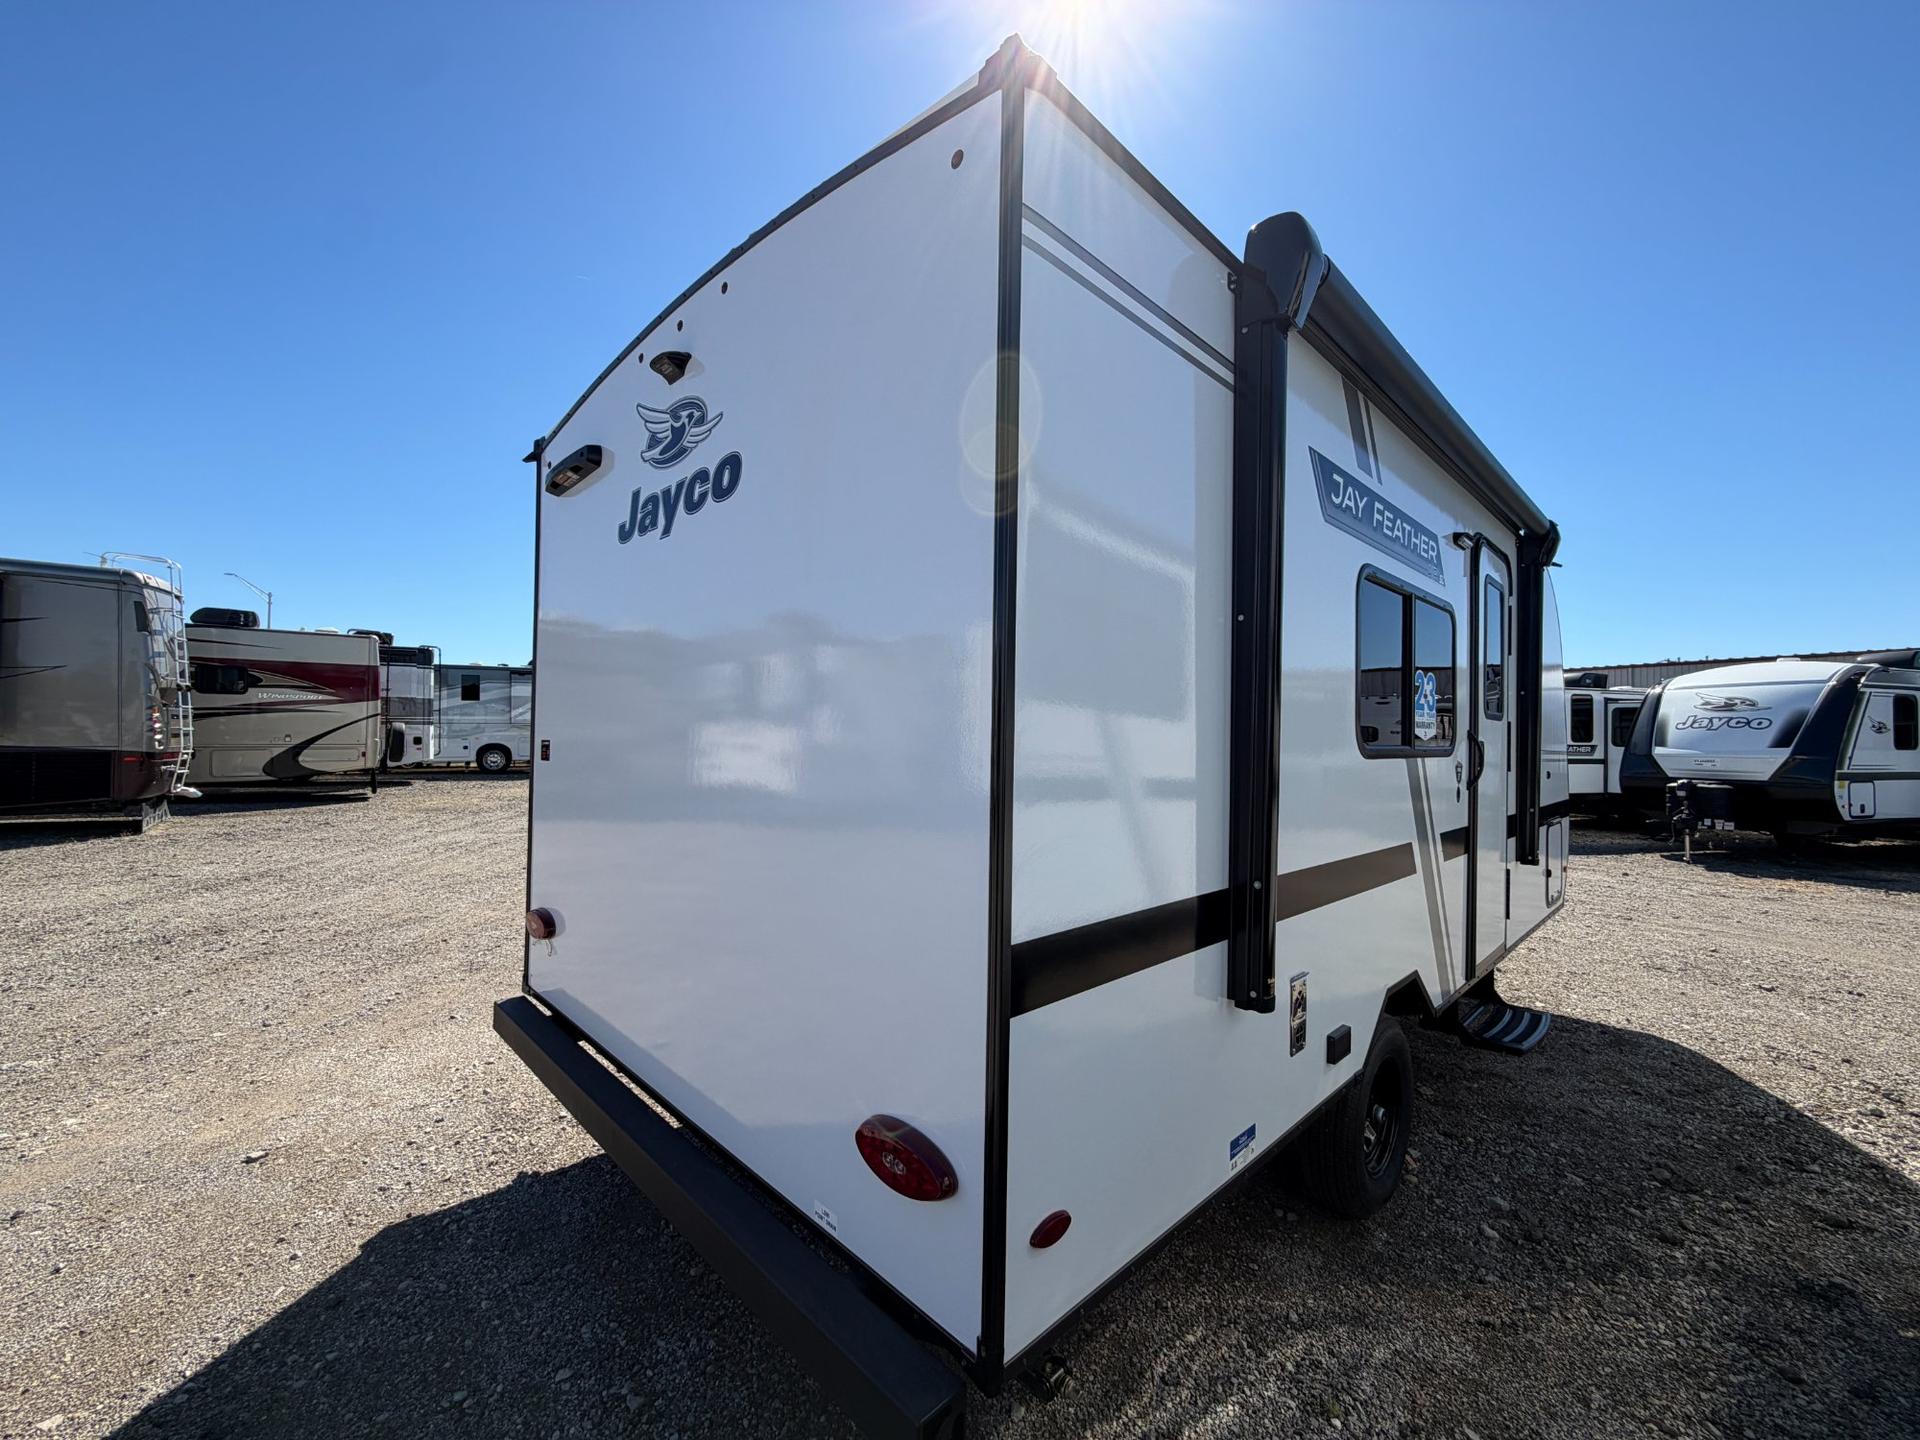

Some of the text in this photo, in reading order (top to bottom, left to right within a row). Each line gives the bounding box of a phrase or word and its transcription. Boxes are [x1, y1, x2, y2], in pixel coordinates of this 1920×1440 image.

[618, 451, 743, 544] Jayco
[1331, 473, 1438, 564] JAY FEATHER
[1675, 714, 1773, 731] Jayco
